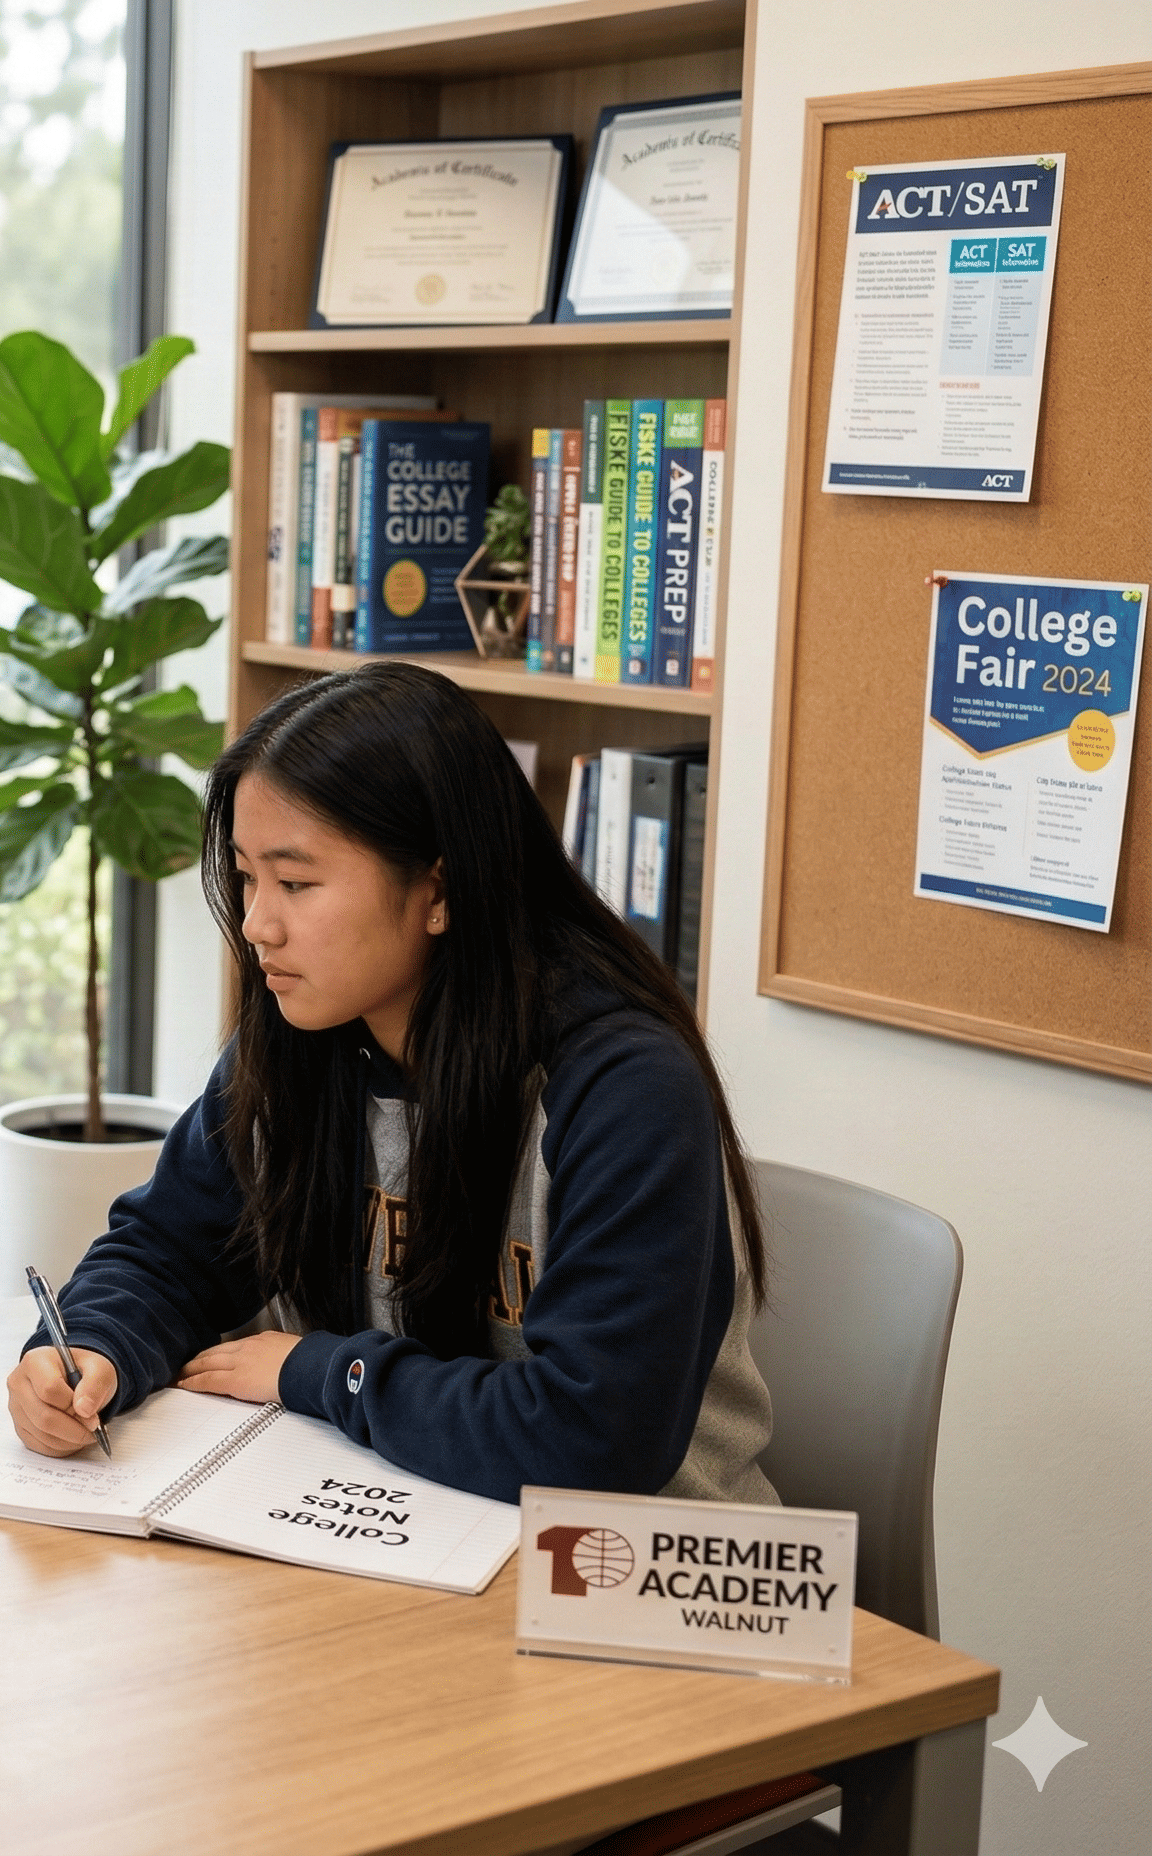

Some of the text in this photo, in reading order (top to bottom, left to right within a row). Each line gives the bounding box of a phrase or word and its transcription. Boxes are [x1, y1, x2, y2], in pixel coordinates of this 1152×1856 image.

[867, 179, 1038, 220] ACT/SAT
[959, 245, 988, 260] ACT
[1007, 243, 1036, 258] SAT
[389, 443, 415, 459] THE
[387, 460, 471, 482] COLLEGE
[982, 474, 1013, 488] ACT
[387, 484, 471, 513] ESSAY
[666, 460, 694, 543] ACT
[385, 516, 468, 544] GUIDE
[602, 414, 629, 640] FISKE GUIDE TO COLLEGES
[629, 412, 657, 641] FISKE GUIDE TO COLLEGES
[663, 549, 690, 623] PREP
[957, 595, 1118, 657] College
[956, 644, 1112, 697] Fair 2024
[321, 1478, 413, 1505] 2024
[301, 1494, 411, 1526] Notes
[267, 1509, 410, 1547] College
[651, 1532, 825, 1574] PREMIER
[638, 1569, 838, 1612] ACADEMY
[681, 1608, 790, 1635] WALNUT
